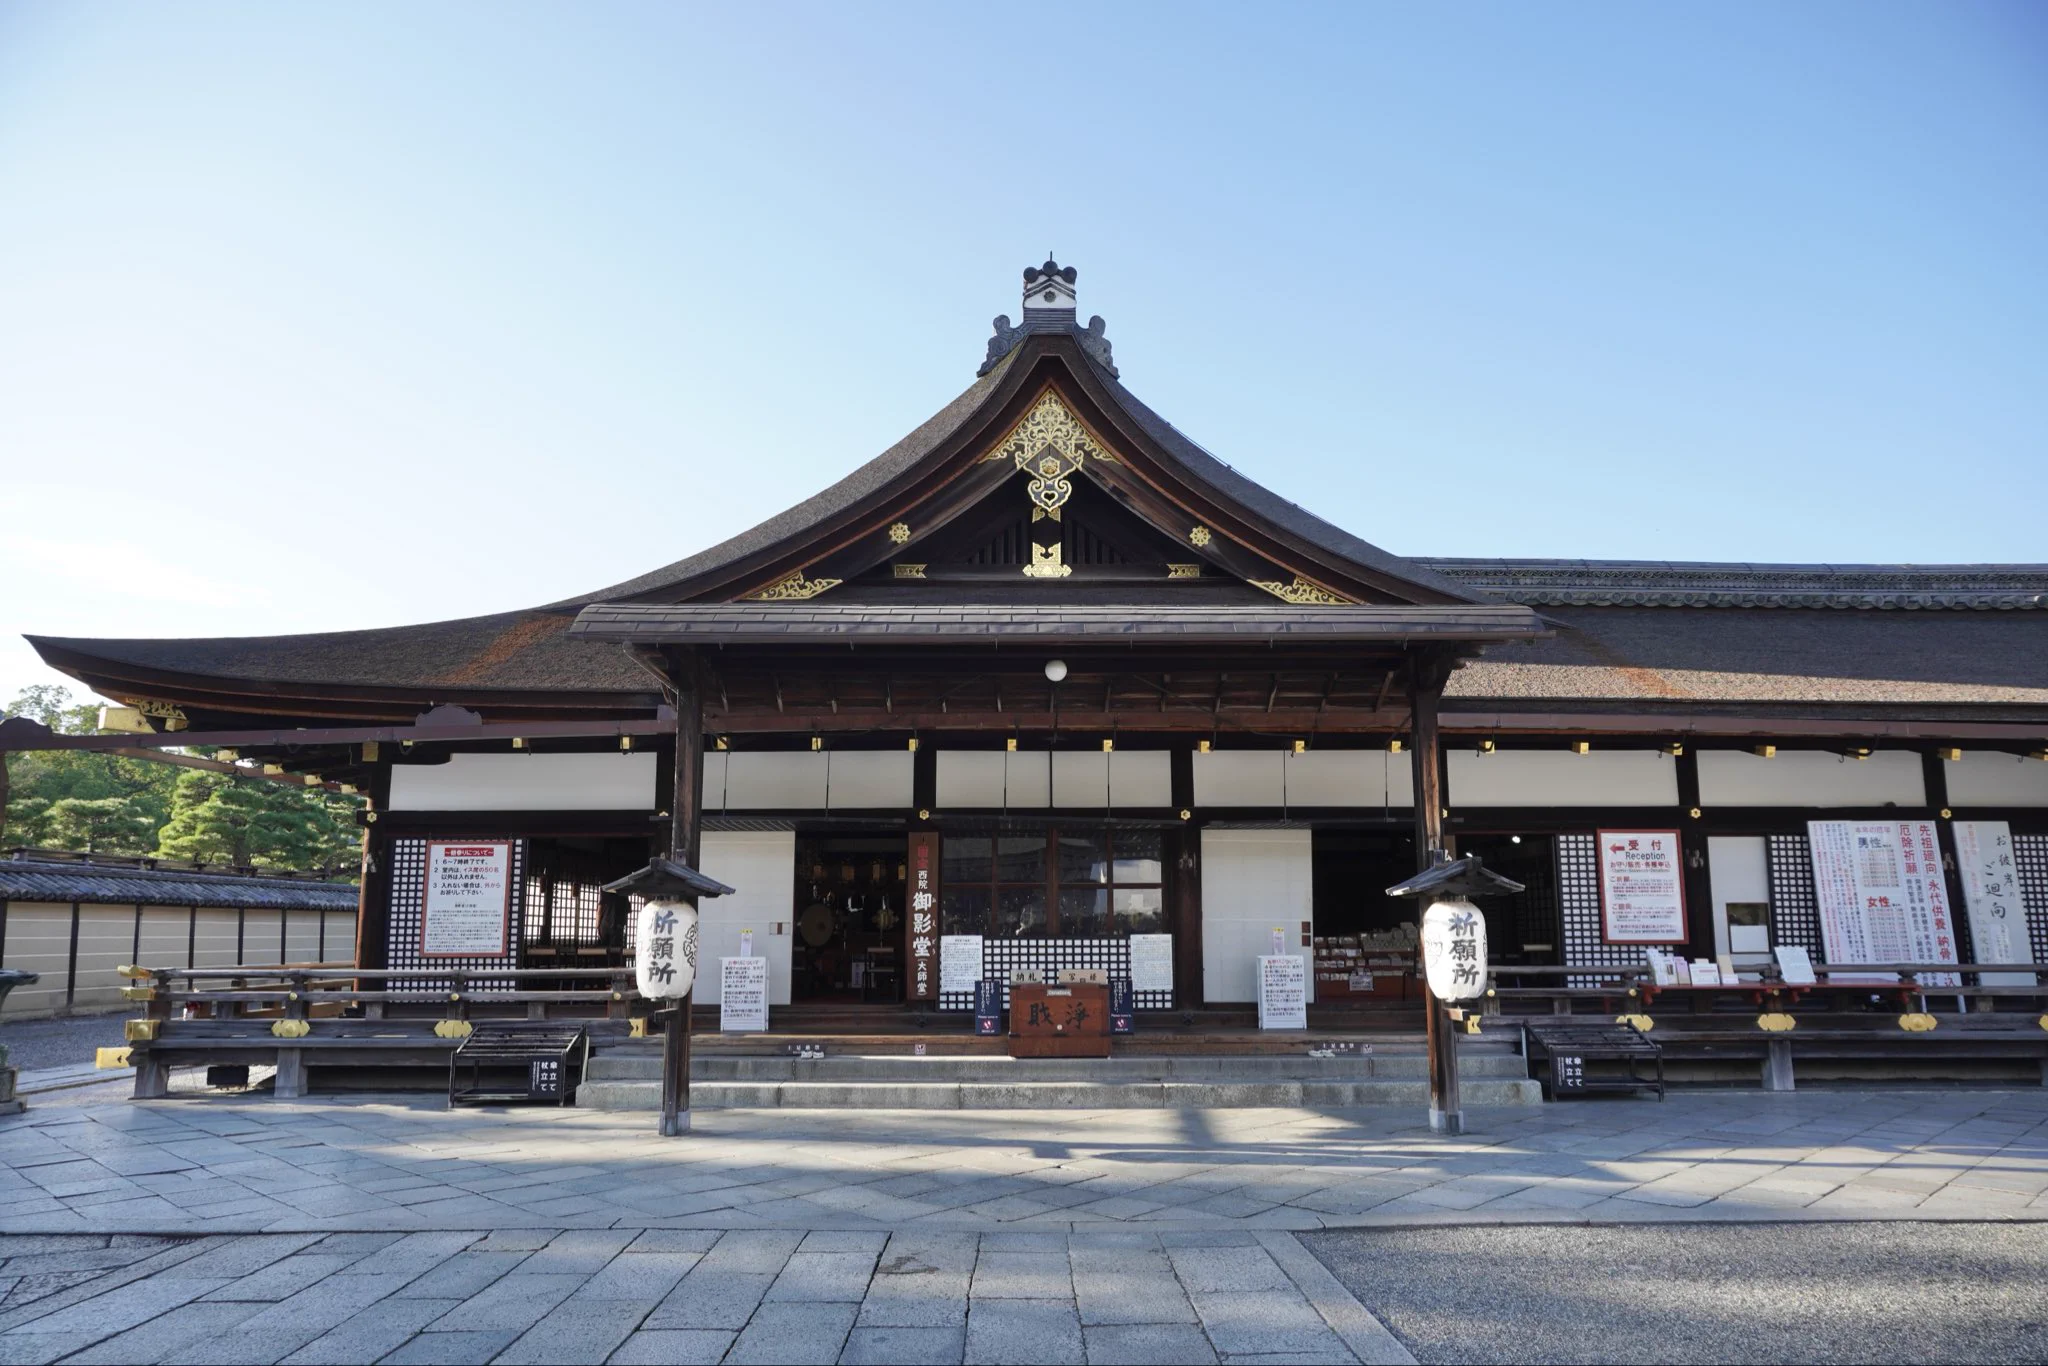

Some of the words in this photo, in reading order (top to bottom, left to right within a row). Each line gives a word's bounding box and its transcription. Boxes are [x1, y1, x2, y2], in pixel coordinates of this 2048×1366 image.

[1625, 852, 1666, 860] Reception
[1628, 840, 1662, 851] 受付
[1858, 837, 1882, 848] 男性
[1900, 825, 1919, 874] 厄除祈願
[917, 870, 928, 890] 西院
[1866, 896, 1889, 908] 女性
[1928, 880, 1947, 930] 永代供養
[912, 891, 932, 958] 御影堂
[648, 910, 679, 985] 祈願所
[1448, 911, 1480, 987] 祈願所
[540, 1061, 549, 1091] 杖立て
[549, 1061, 558, 1091] 傘立て
